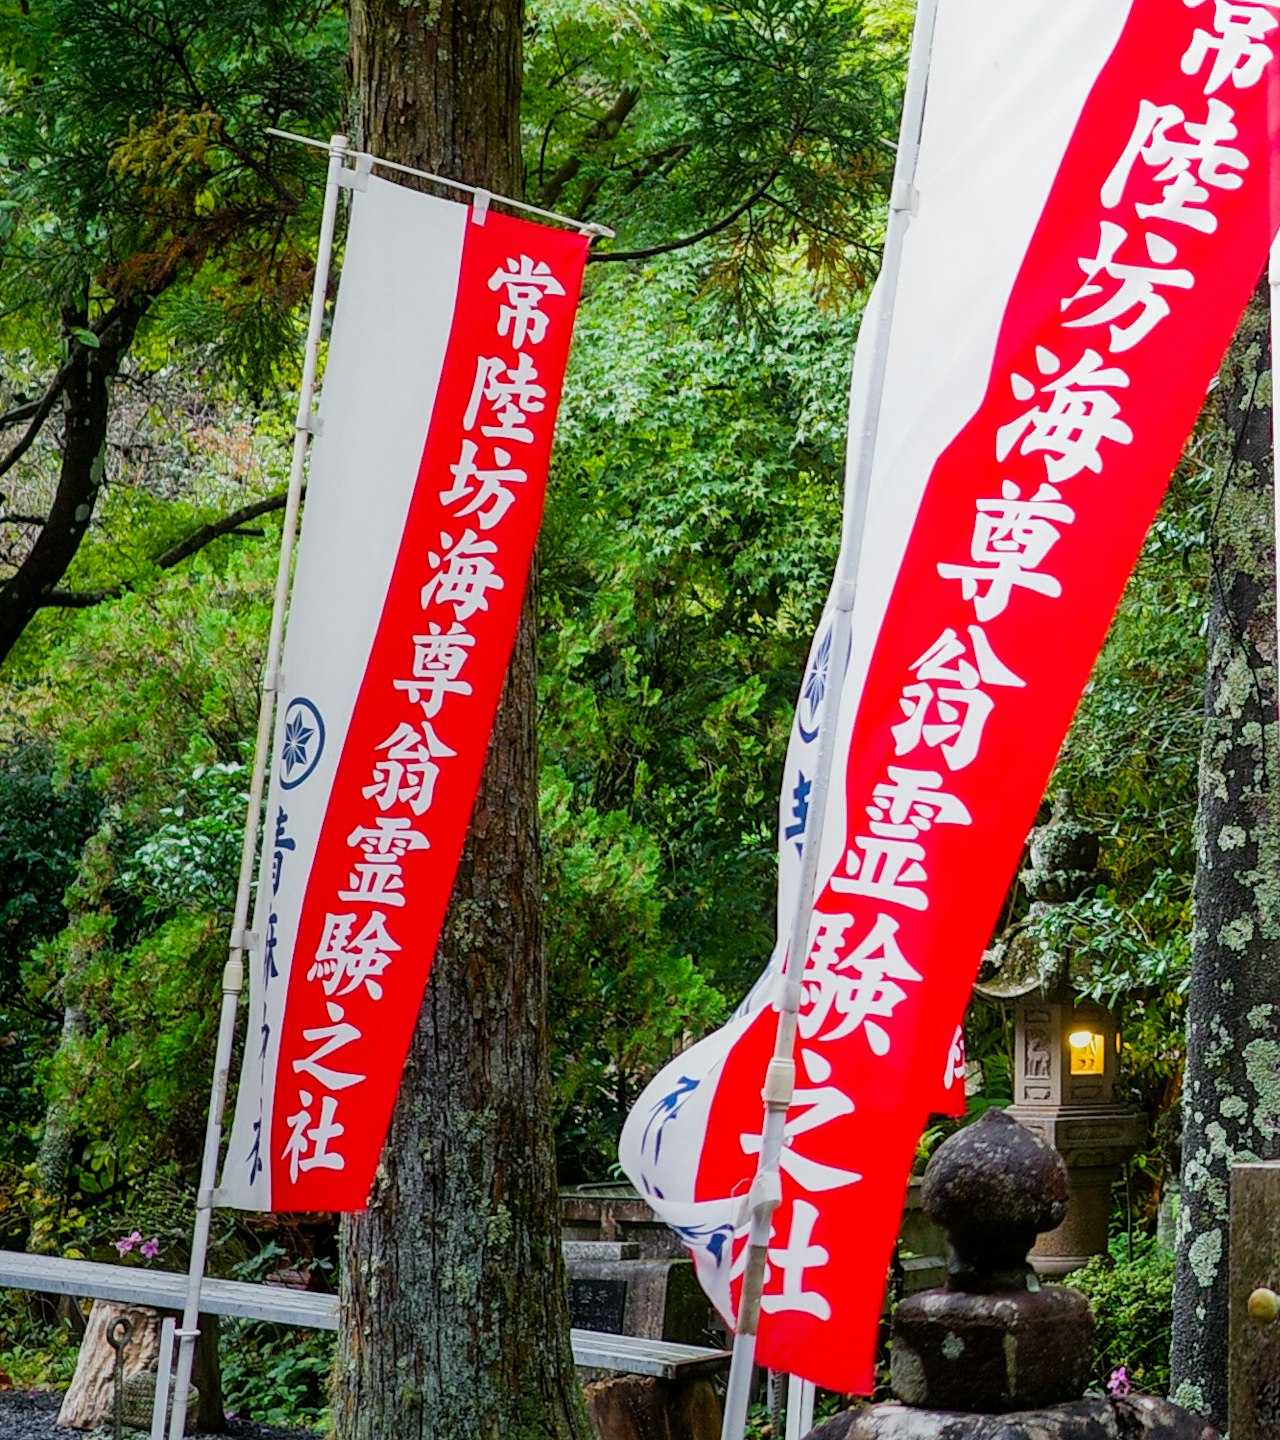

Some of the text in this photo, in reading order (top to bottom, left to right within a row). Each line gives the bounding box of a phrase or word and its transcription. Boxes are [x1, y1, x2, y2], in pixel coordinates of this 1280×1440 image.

[282, 254, 566, 1184] 常陸坊海尊翁霊験之社
